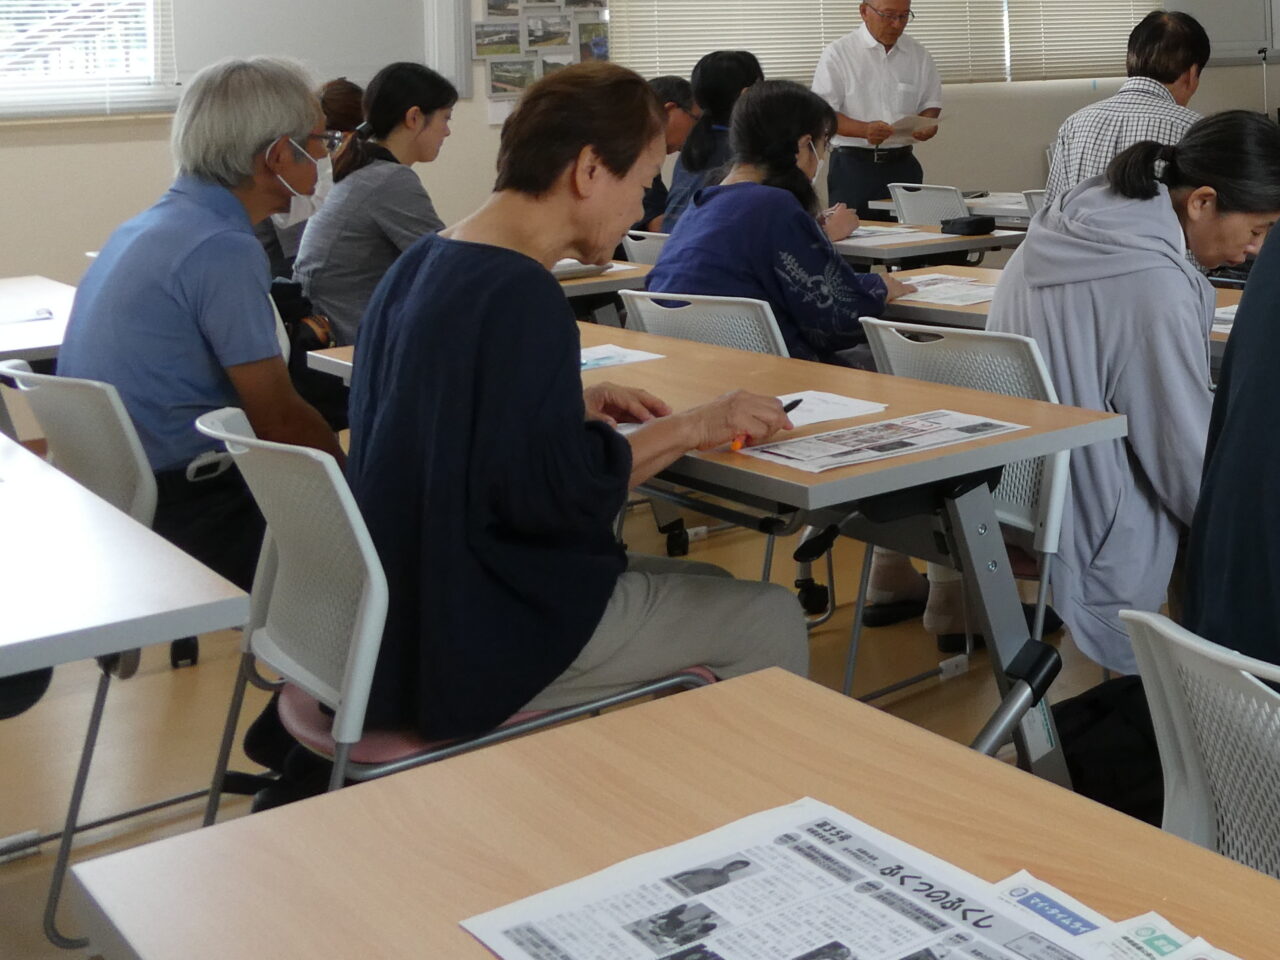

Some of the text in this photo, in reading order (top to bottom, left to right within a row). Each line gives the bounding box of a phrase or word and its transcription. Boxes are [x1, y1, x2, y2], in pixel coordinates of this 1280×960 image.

[879, 864, 995, 929] ふくつのふくし
